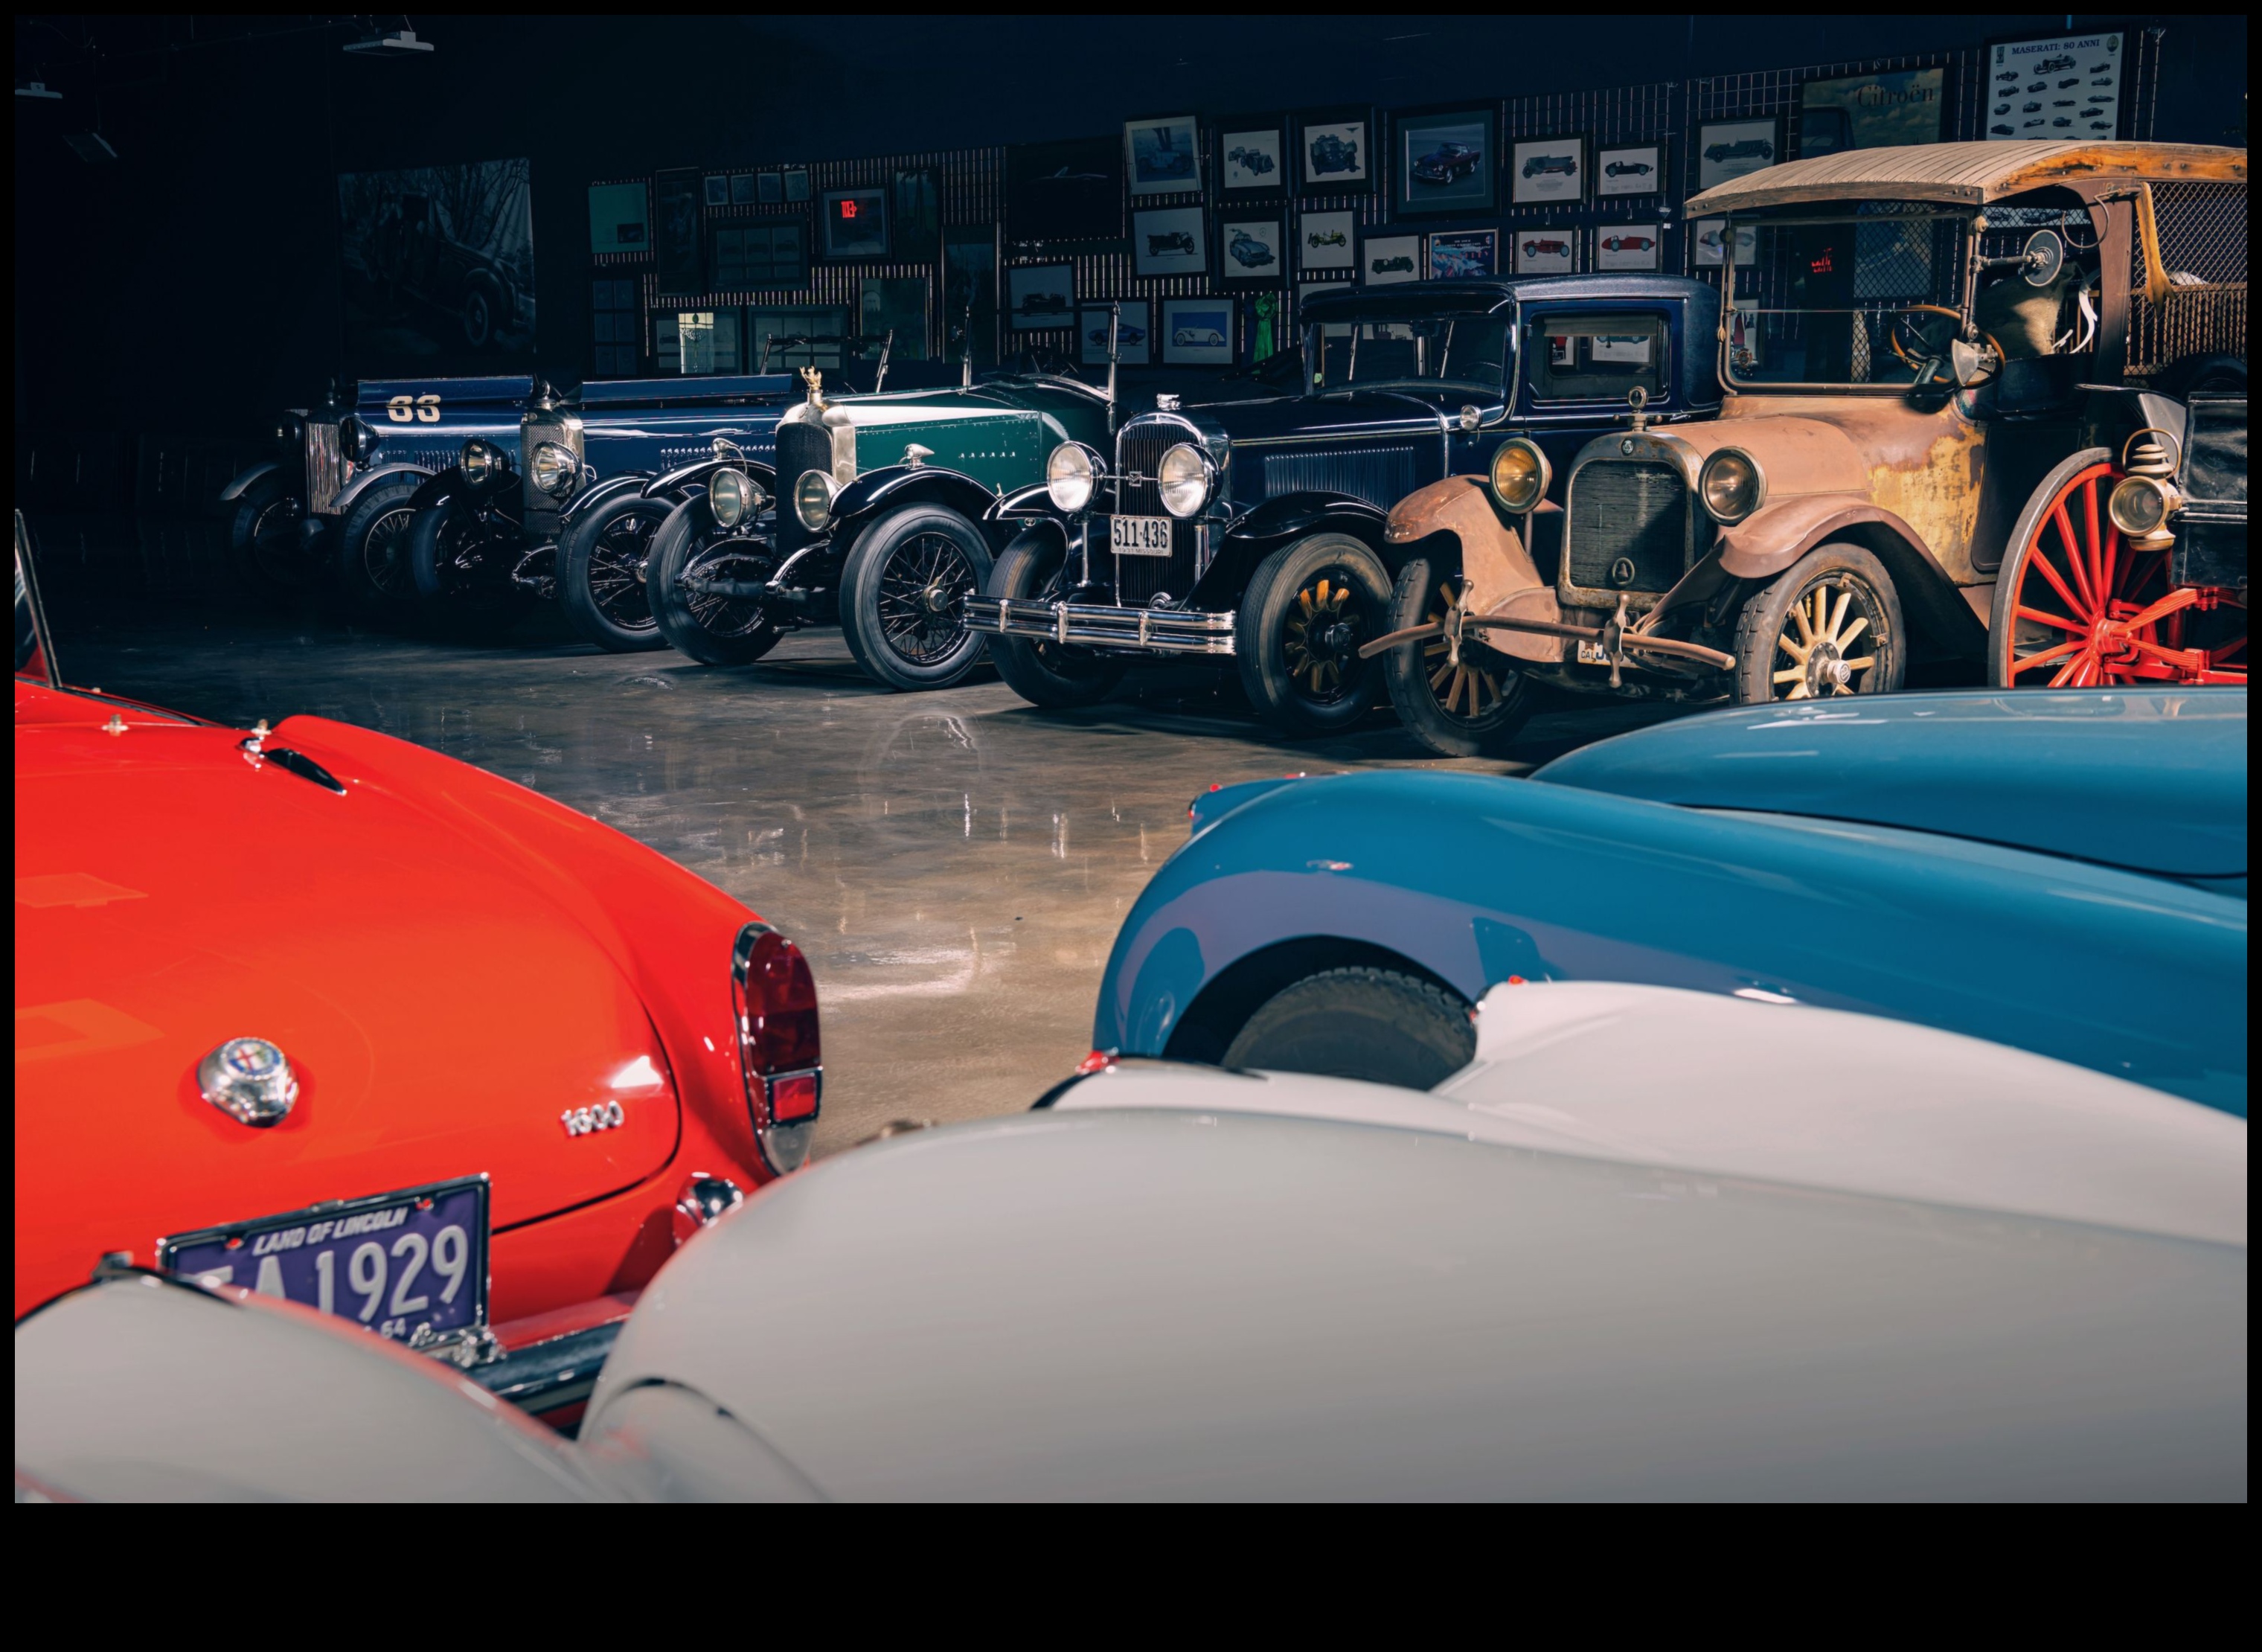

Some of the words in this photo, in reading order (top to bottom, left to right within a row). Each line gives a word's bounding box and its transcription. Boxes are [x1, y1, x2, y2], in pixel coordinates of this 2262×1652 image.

[2011, 44, 2060, 54] MASERATI:
[2063, 42, 2074, 50] 80
[2077, 39, 2100, 48] ANNI
[1857, 83, 1934, 108] Citroën
[560, 1100, 624, 1137] 1600
[252, 1227, 306, 1256] LAND
[306, 1220, 335, 1245] OF
[332, 1206, 408, 1239] LINCOLN
[380, 1317, 406, 1339] 64
